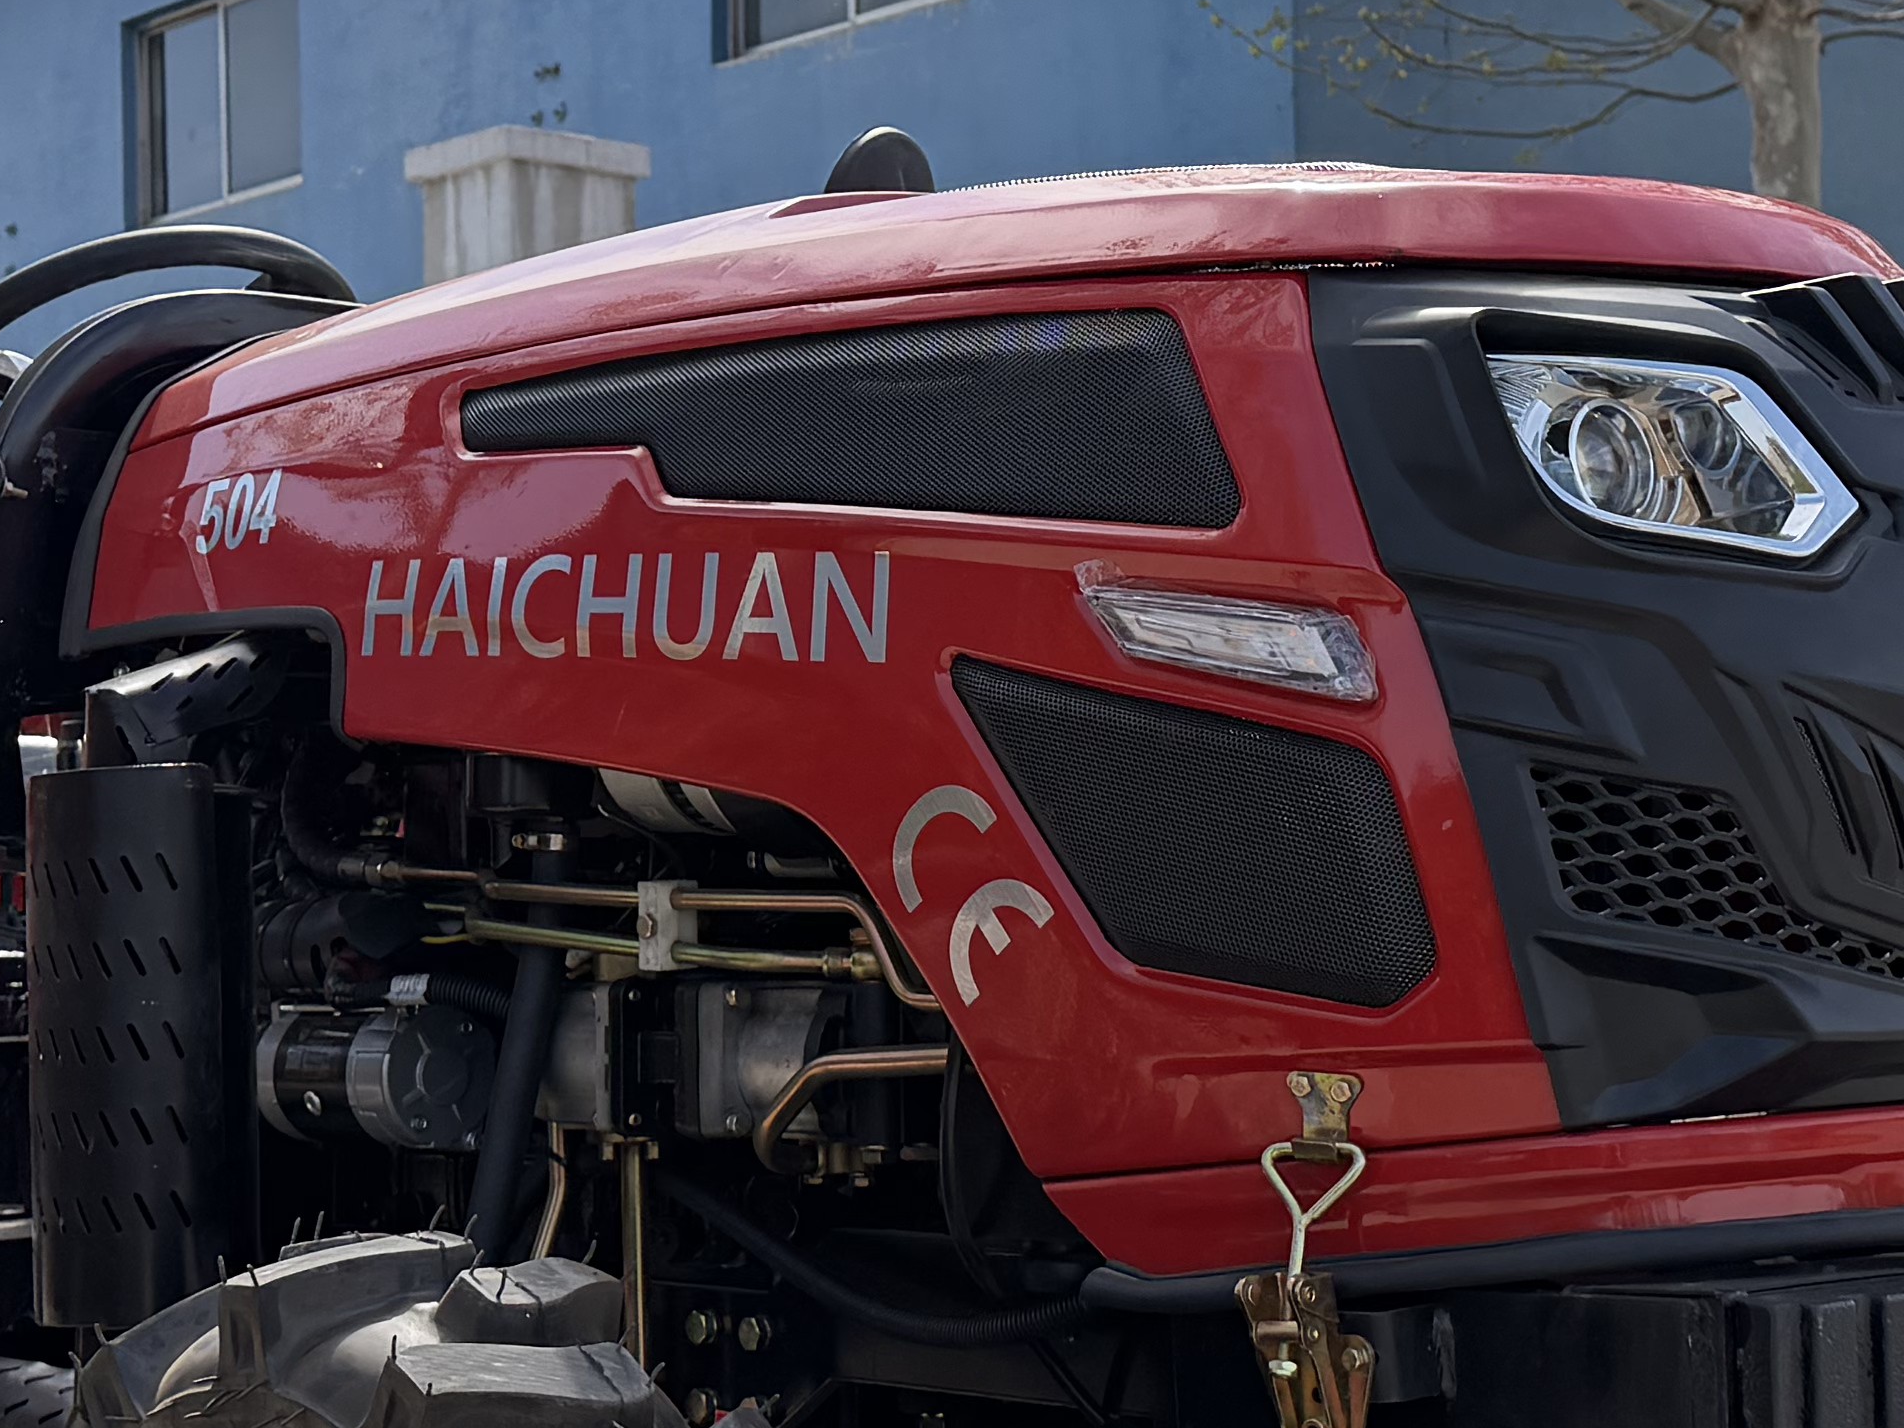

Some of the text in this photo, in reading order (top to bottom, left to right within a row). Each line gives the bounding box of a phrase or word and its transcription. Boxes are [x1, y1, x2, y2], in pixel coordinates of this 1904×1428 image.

[195, 468, 284, 556] 504
[360, 549, 892, 664] HAICHUAN
[891, 784, 1055, 1007] CE
